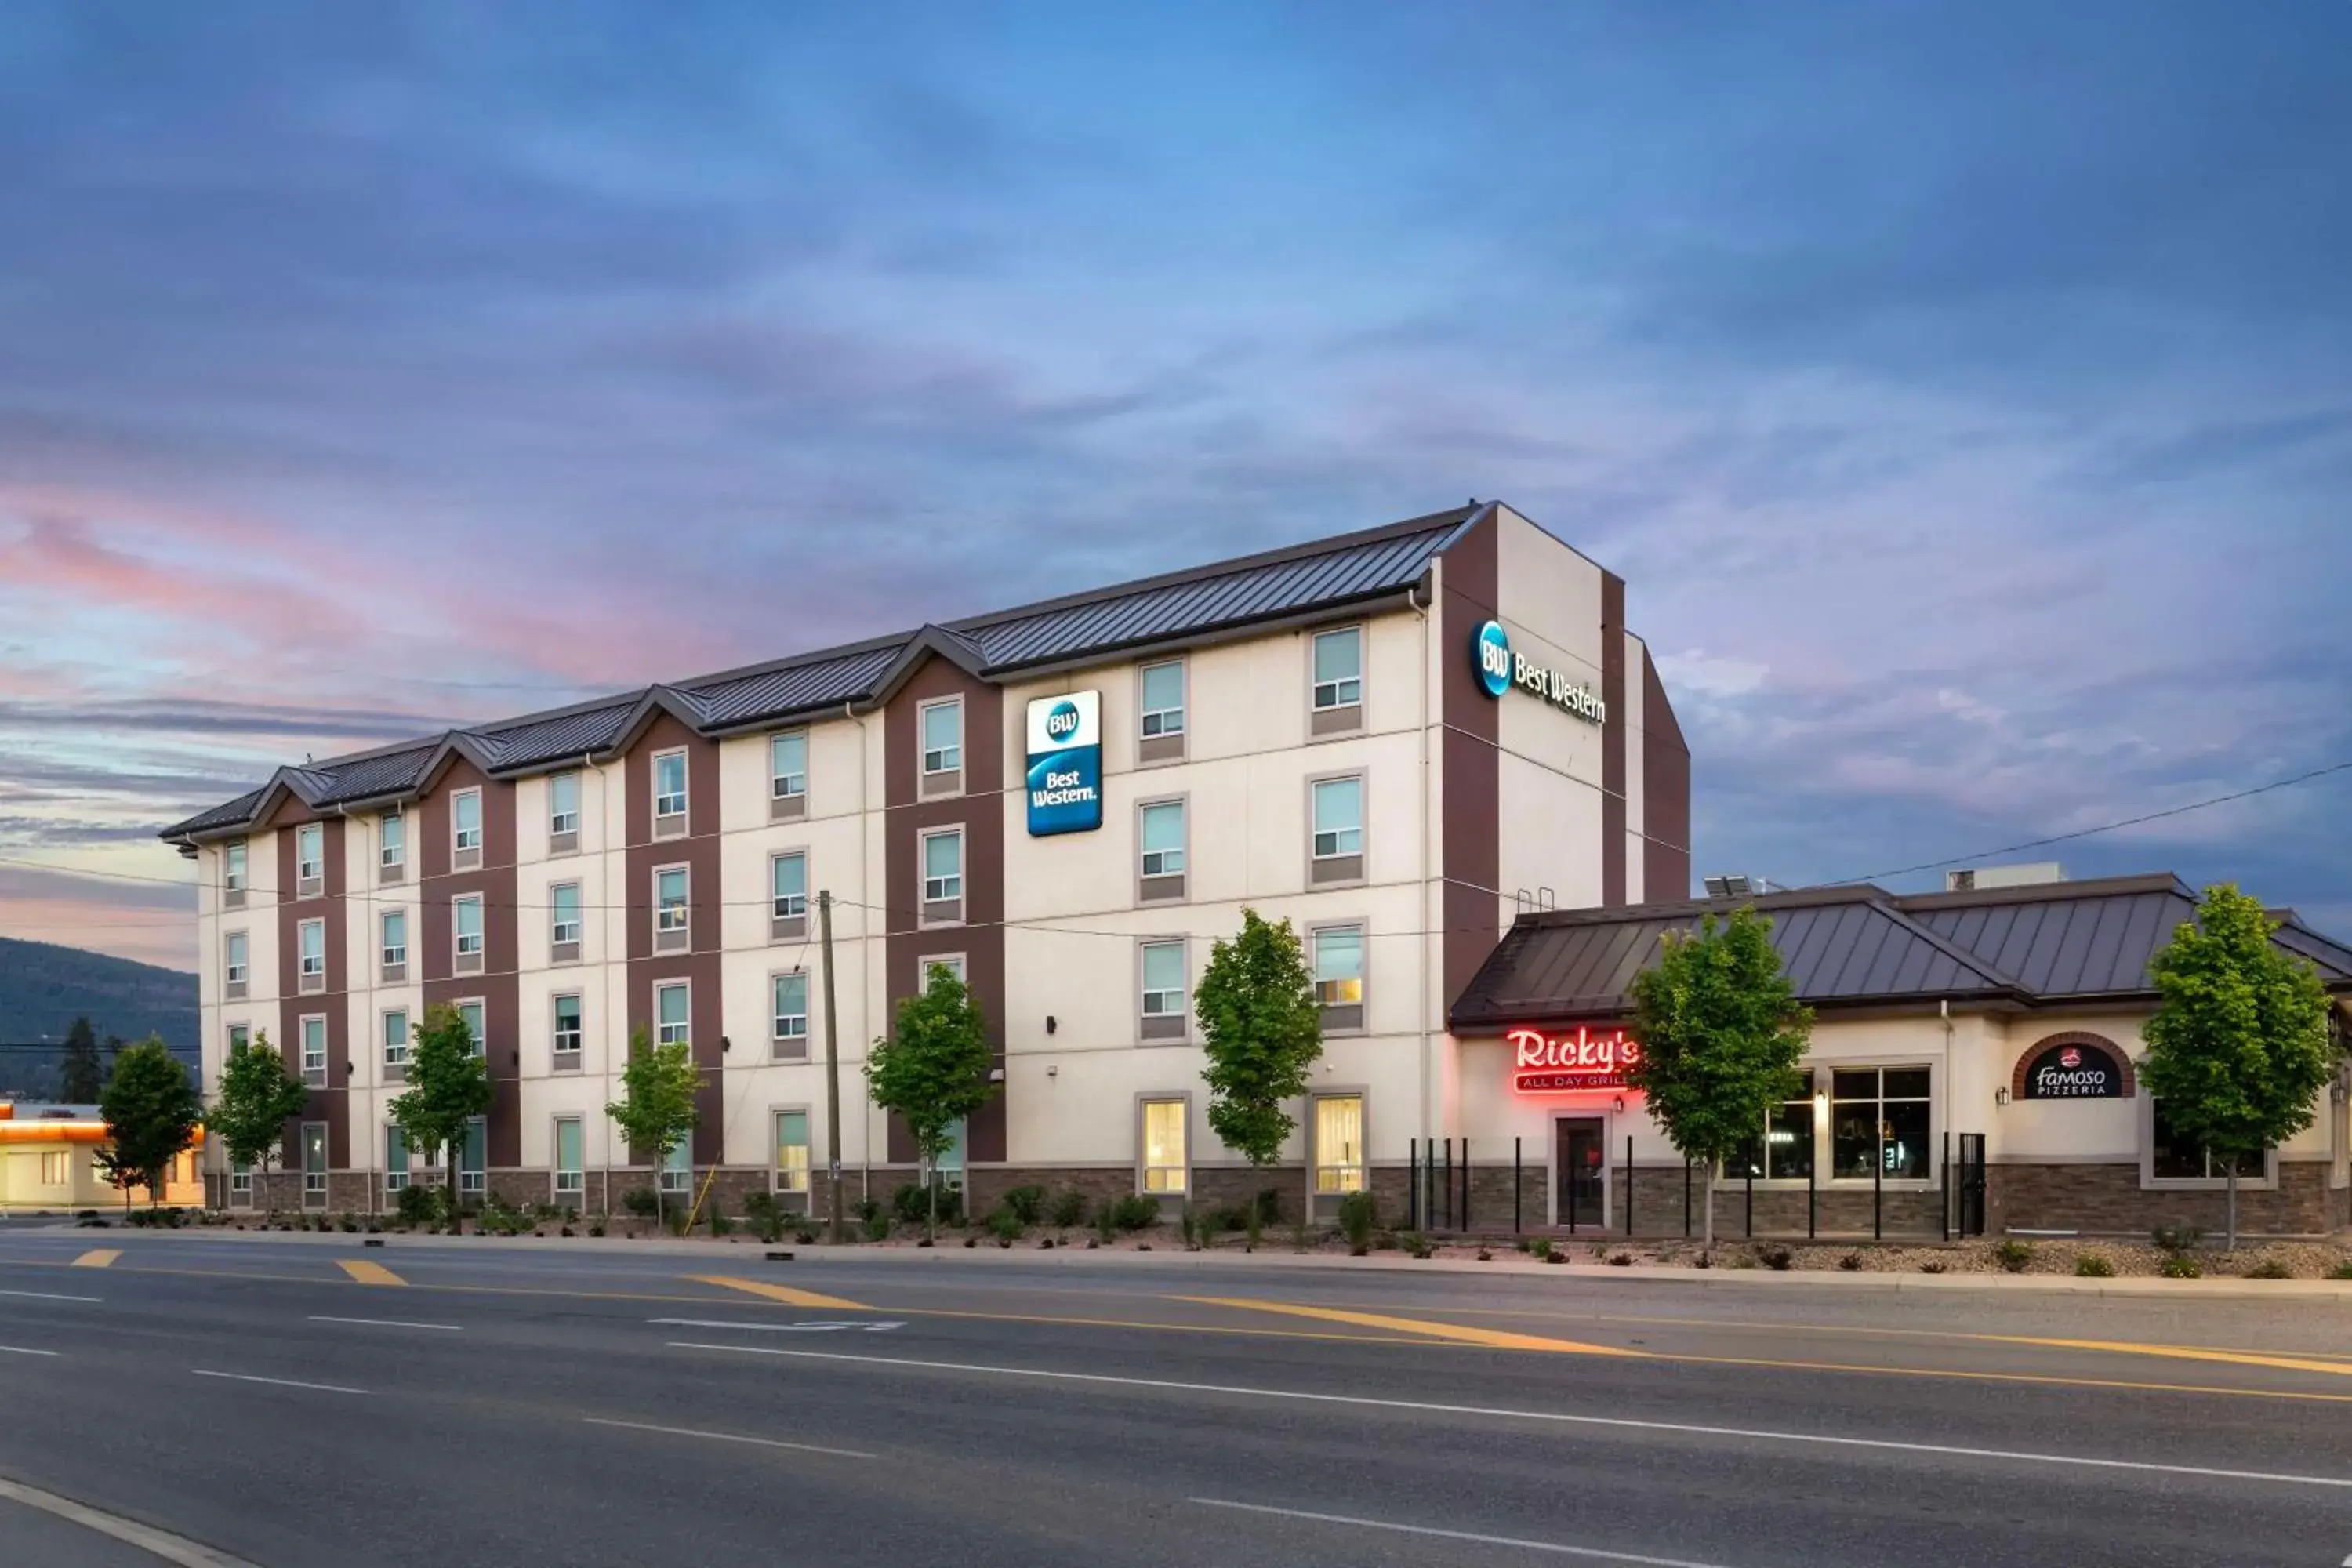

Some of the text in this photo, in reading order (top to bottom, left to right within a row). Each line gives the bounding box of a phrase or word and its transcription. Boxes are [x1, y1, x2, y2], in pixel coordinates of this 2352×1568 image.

[1483, 640, 1508, 678] BW
[1515, 652, 1606, 724] Best Western
[1050, 713, 1076, 733] BW
[1047, 771, 1080, 788] Best
[1507, 1026, 1639, 1073] Ricky's
[1523, 1078, 1549, 1087] ALL
[1555, 1076, 1582, 1086] DAY
[2038, 1086, 2105, 1095] PIZZERIA
